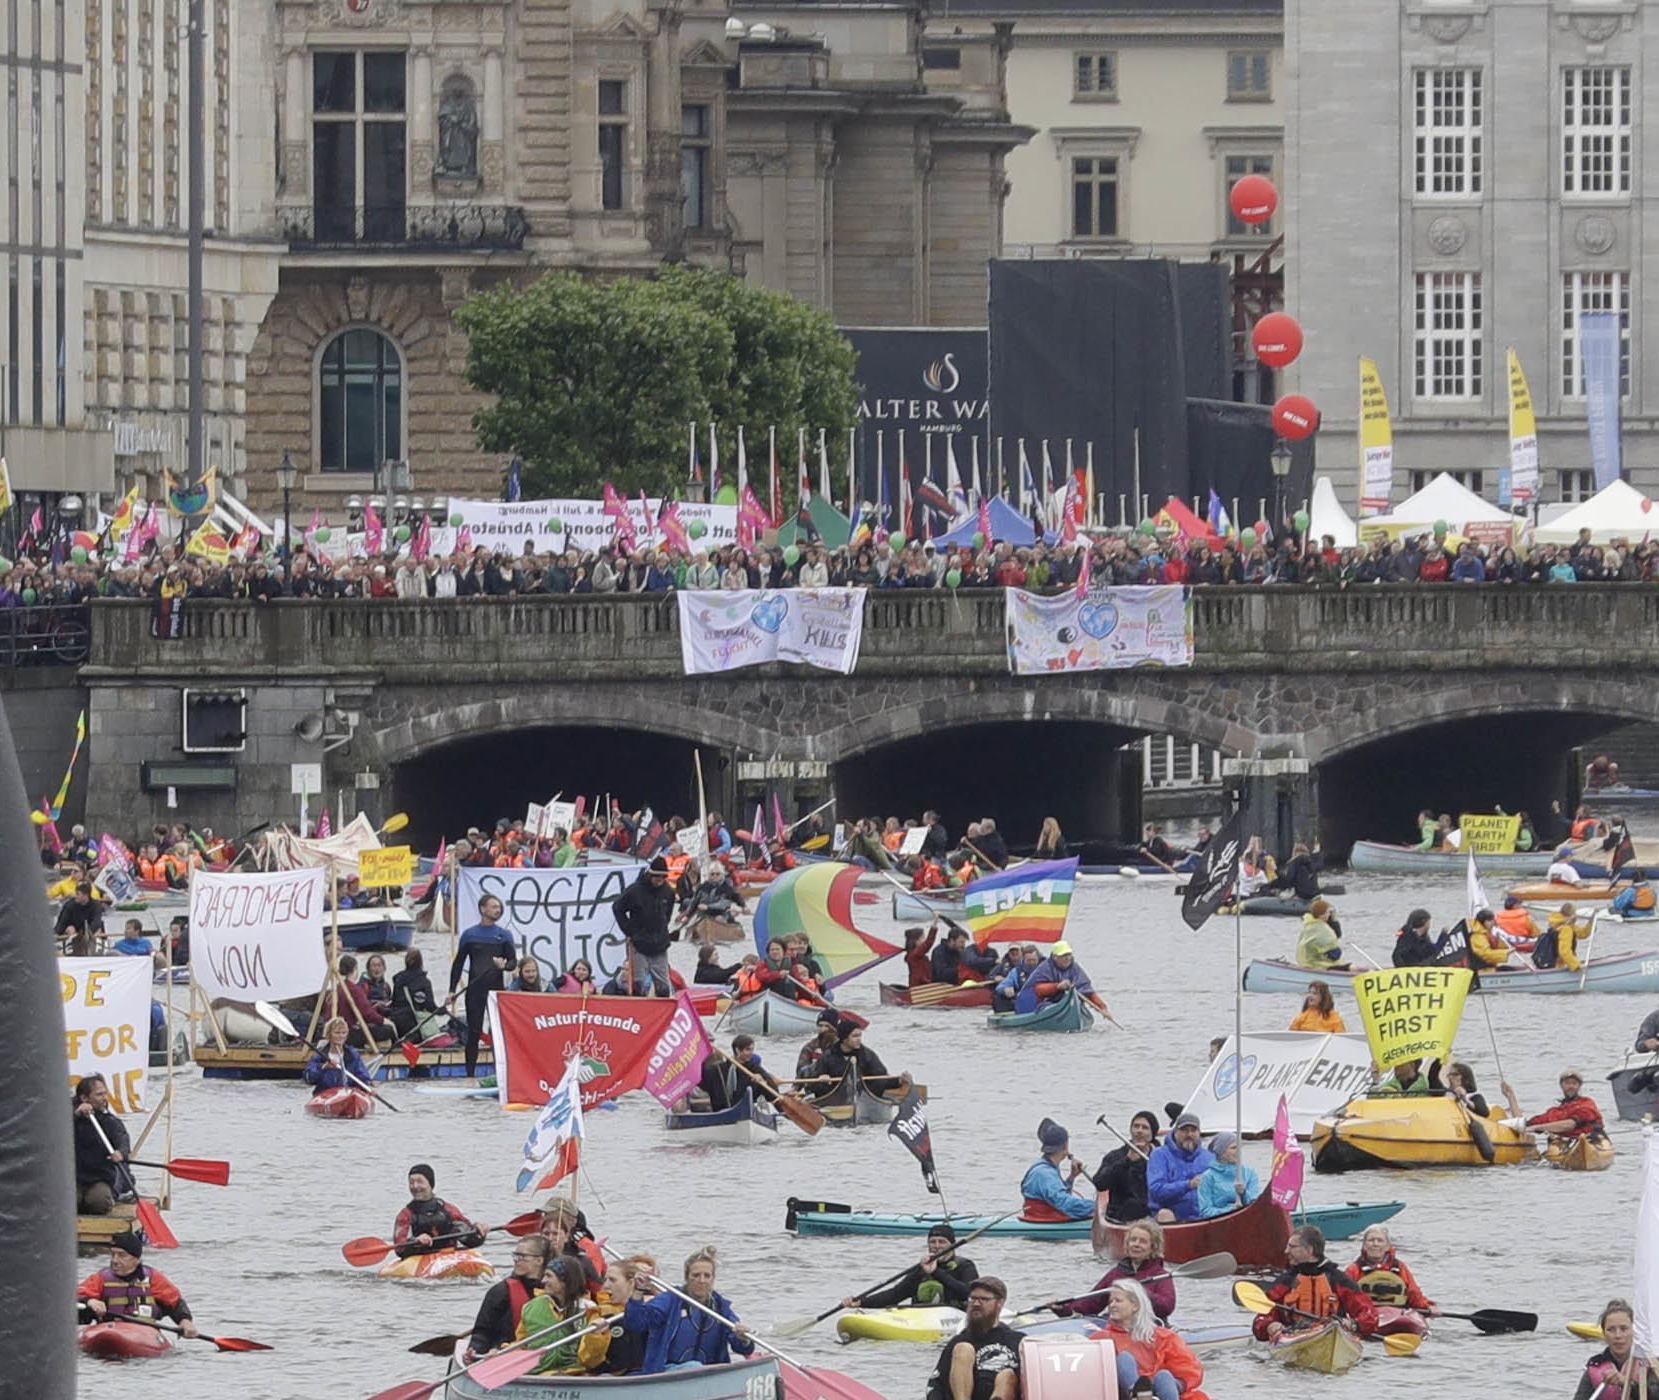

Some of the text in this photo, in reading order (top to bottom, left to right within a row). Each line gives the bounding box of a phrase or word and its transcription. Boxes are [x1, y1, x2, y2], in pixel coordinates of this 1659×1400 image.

[854, 399, 942, 418] ALTER
[920, 424, 962, 432] HAMBURG
[1464, 818, 1510, 829] PLANET
[1468, 830, 1506, 840] EARTH
[1364, 972, 1453, 997] PLANET
[1372, 993, 1445, 1019] EARTH
[534, 1011, 642, 1035] NaturFreunde
[1379, 1014, 1437, 1041] FIRST
[65, 1024, 138, 1061] FOR
[1382, 1041, 1439, 1064] GREENPEACE
[1045, 1352, 1085, 1373] 17
